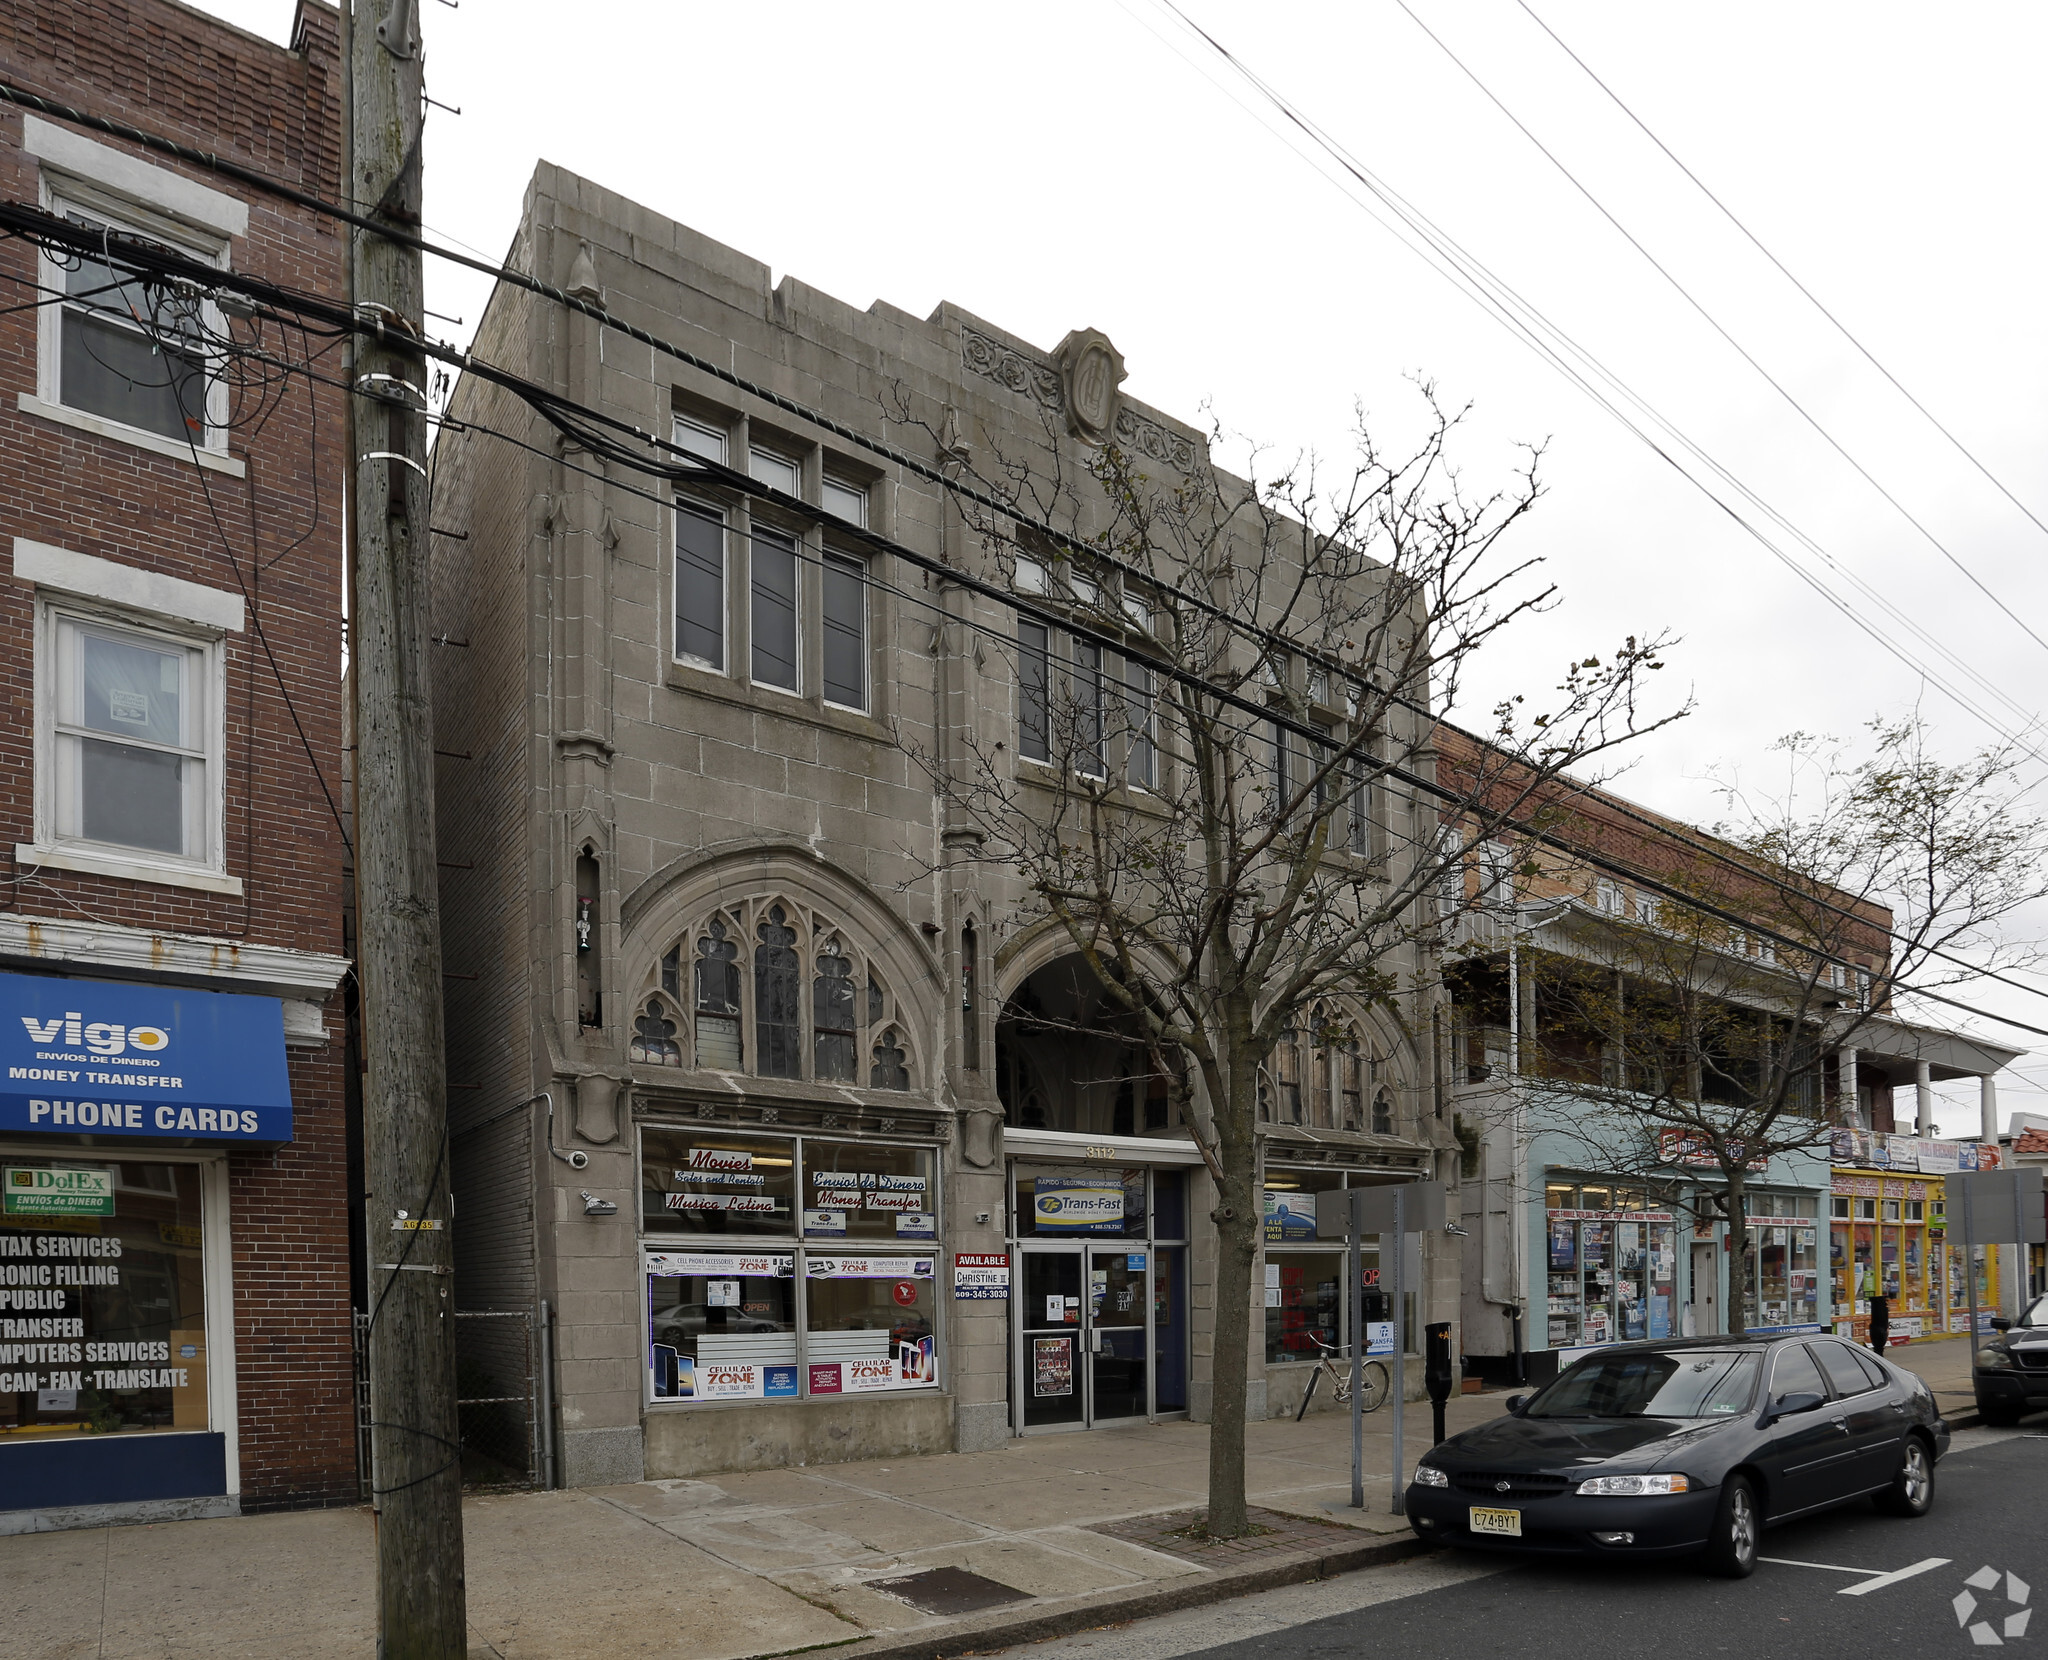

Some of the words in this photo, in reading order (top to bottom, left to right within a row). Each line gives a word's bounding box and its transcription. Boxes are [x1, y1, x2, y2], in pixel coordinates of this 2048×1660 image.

[20, 1011, 169, 1055] vigo
[36, 1052, 87, 1063] ENVÍOS
[90, 1056, 108, 1064] DE
[112, 1057, 161, 1067] DINERO
[9, 1067, 81, 1083] MONEY
[86, 1071, 184, 1089] TRANSFER
[29, 1099, 143, 1128] PHONE
[154, 1106, 259, 1134] CARDS
[1086, 1146, 1116, 1160] 3112
[691, 1150, 751, 1171] Movies
[35, 1171, 104, 1191] DolEx
[675, 1171, 703, 1182] Sales
[705, 1174, 725, 1184] and
[728, 1175, 764, 1186] Rentals
[814, 1172, 857, 1188] Envios
[860, 1174, 876, 1189] de
[879, 1176, 926, 1190] Dinero
[16, 1194, 52, 1205] ENVÍOS
[53, 1197, 66, 1205] de
[67, 1198, 104, 1207] DINERO
[667, 1194, 720, 1210] Musica
[725, 1197, 774, 1212] Latina
[818, 1190, 862, 1209] Money
[866, 1193, 921, 1211] Transfer
[1062, 1197, 1121, 1210] Trans-Fast
[0, 1236, 33, 1257] TAX
[36, 1236, 122, 1258] SERVICES
[688, 1257, 704, 1265] PHONE
[738, 1262, 769, 1271] ZONE
[958, 1255, 1006, 1265] AVAILABLE
[841, 1264, 869, 1272] ZONE
[55, 1265, 119, 1286] FILLING
[957, 1271, 997, 1283] CHRISTINE
[1363, 1269, 1380, 1286] OP
[0, 1289, 66, 1309] PUBLIC
[955, 1290, 1008, 1299] 609-345-3030
[1117, 1292, 1134, 1302] COPY
[743, 1303, 770, 1312] OPEN
[1117, 1302, 1129, 1311] FAX
[86, 1341, 169, 1363] SERVICES
[709, 1365, 753, 1374] CELLULAR
[852, 1359, 891, 1368] CELLULAR
[707, 1373, 755, 1385] ZONE
[851, 1366, 893, 1378] ZONE
[50, 1370, 83, 1391] FAX
[94, 1368, 188, 1390] TRANSLATE
